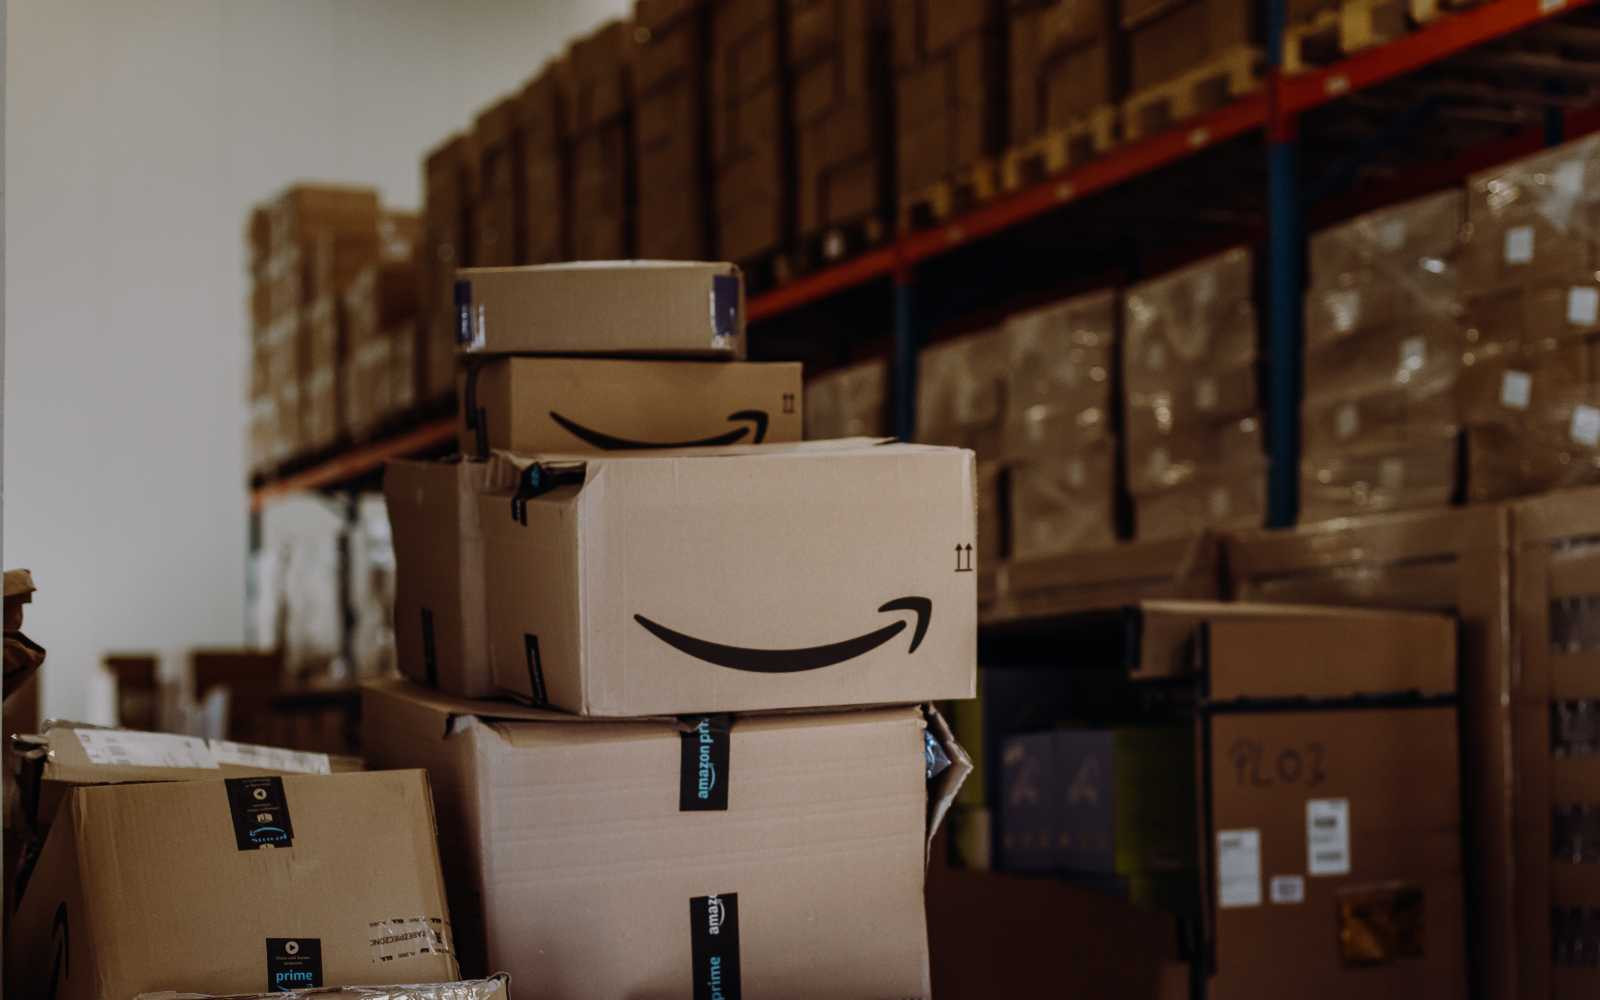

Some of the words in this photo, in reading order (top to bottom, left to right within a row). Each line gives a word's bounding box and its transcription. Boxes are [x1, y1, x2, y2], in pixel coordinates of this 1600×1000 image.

[697, 745, 711, 799] amazon
[276, 969, 313, 984] prime
[707, 956, 723, 1000] prime
